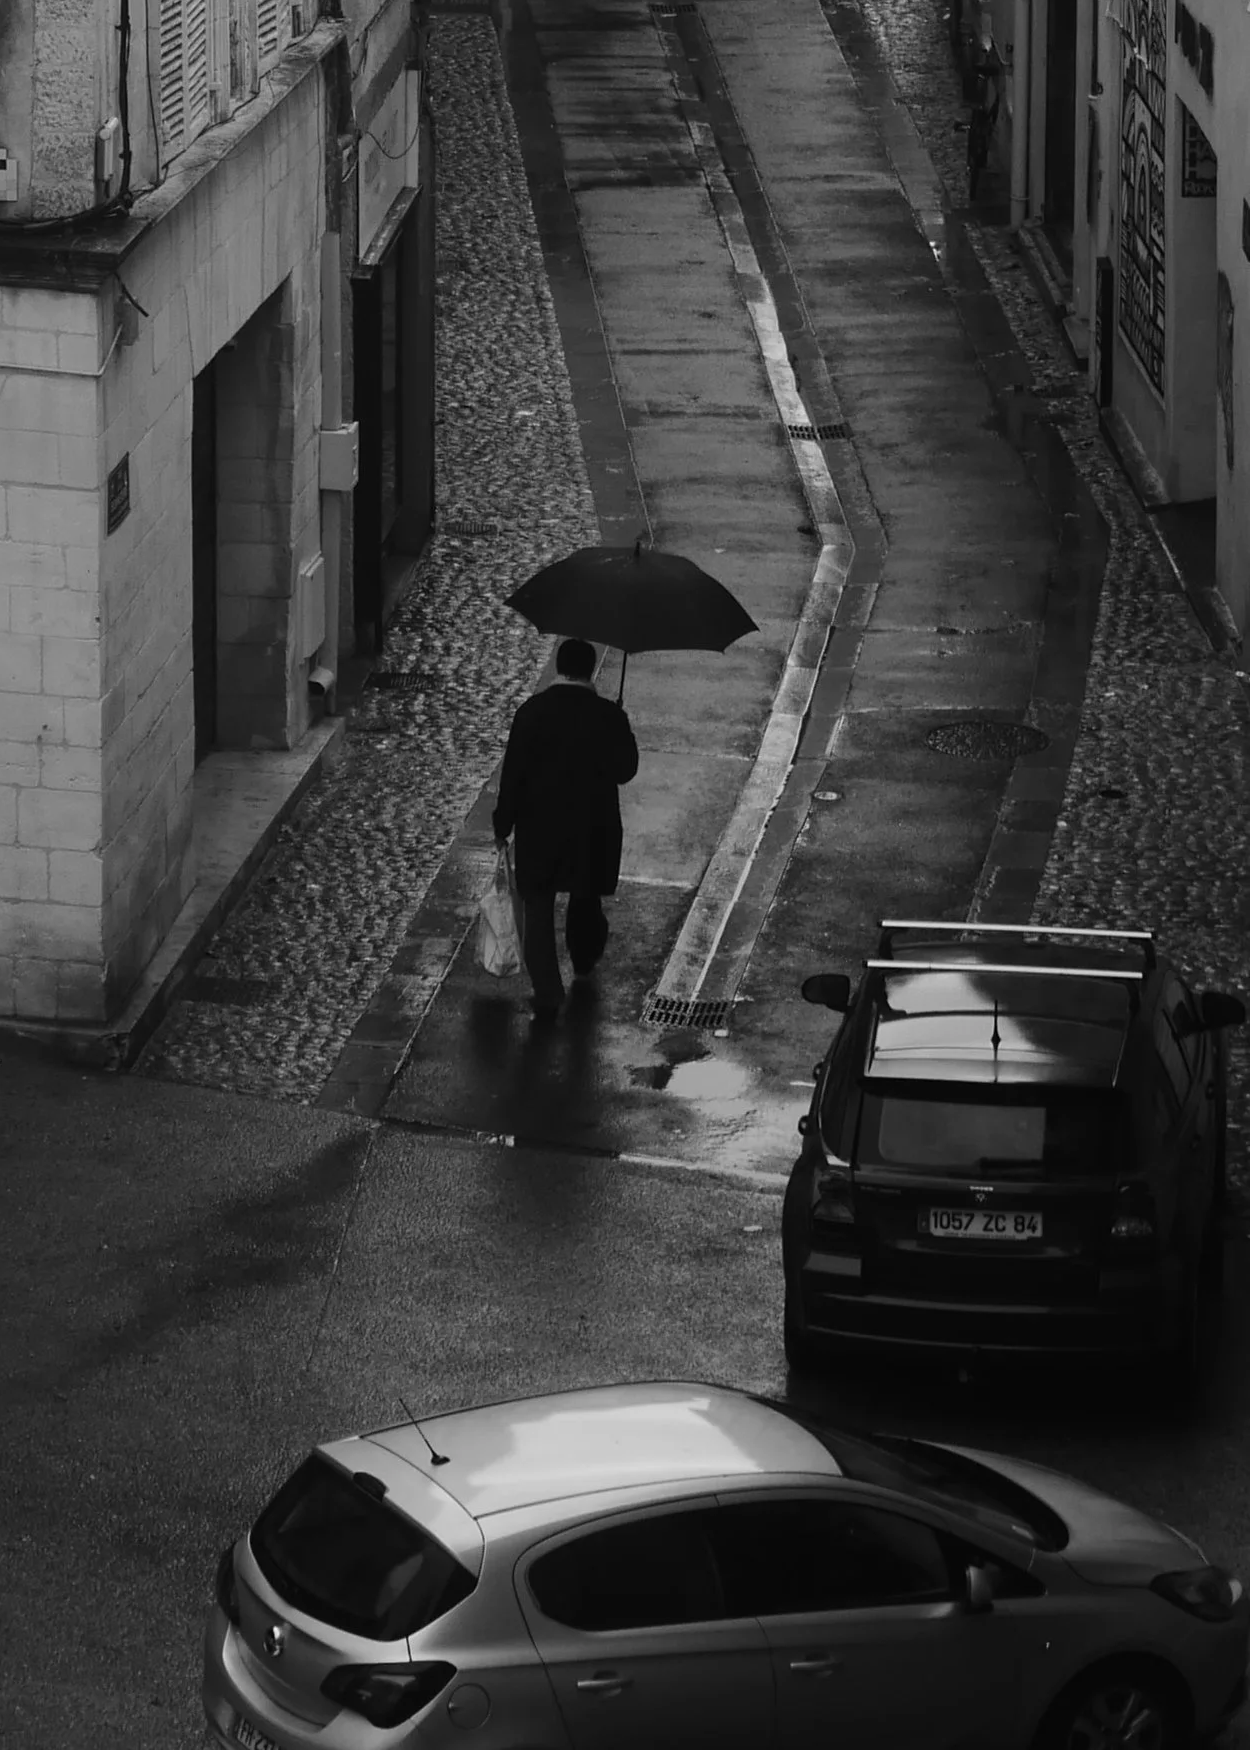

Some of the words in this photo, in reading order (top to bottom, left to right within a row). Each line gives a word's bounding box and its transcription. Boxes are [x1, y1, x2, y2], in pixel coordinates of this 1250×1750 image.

[932, 1211, 975, 1231] 1057
[982, 1214, 1006, 1232] ZC
[1014, 1215, 1038, 1234] 84
